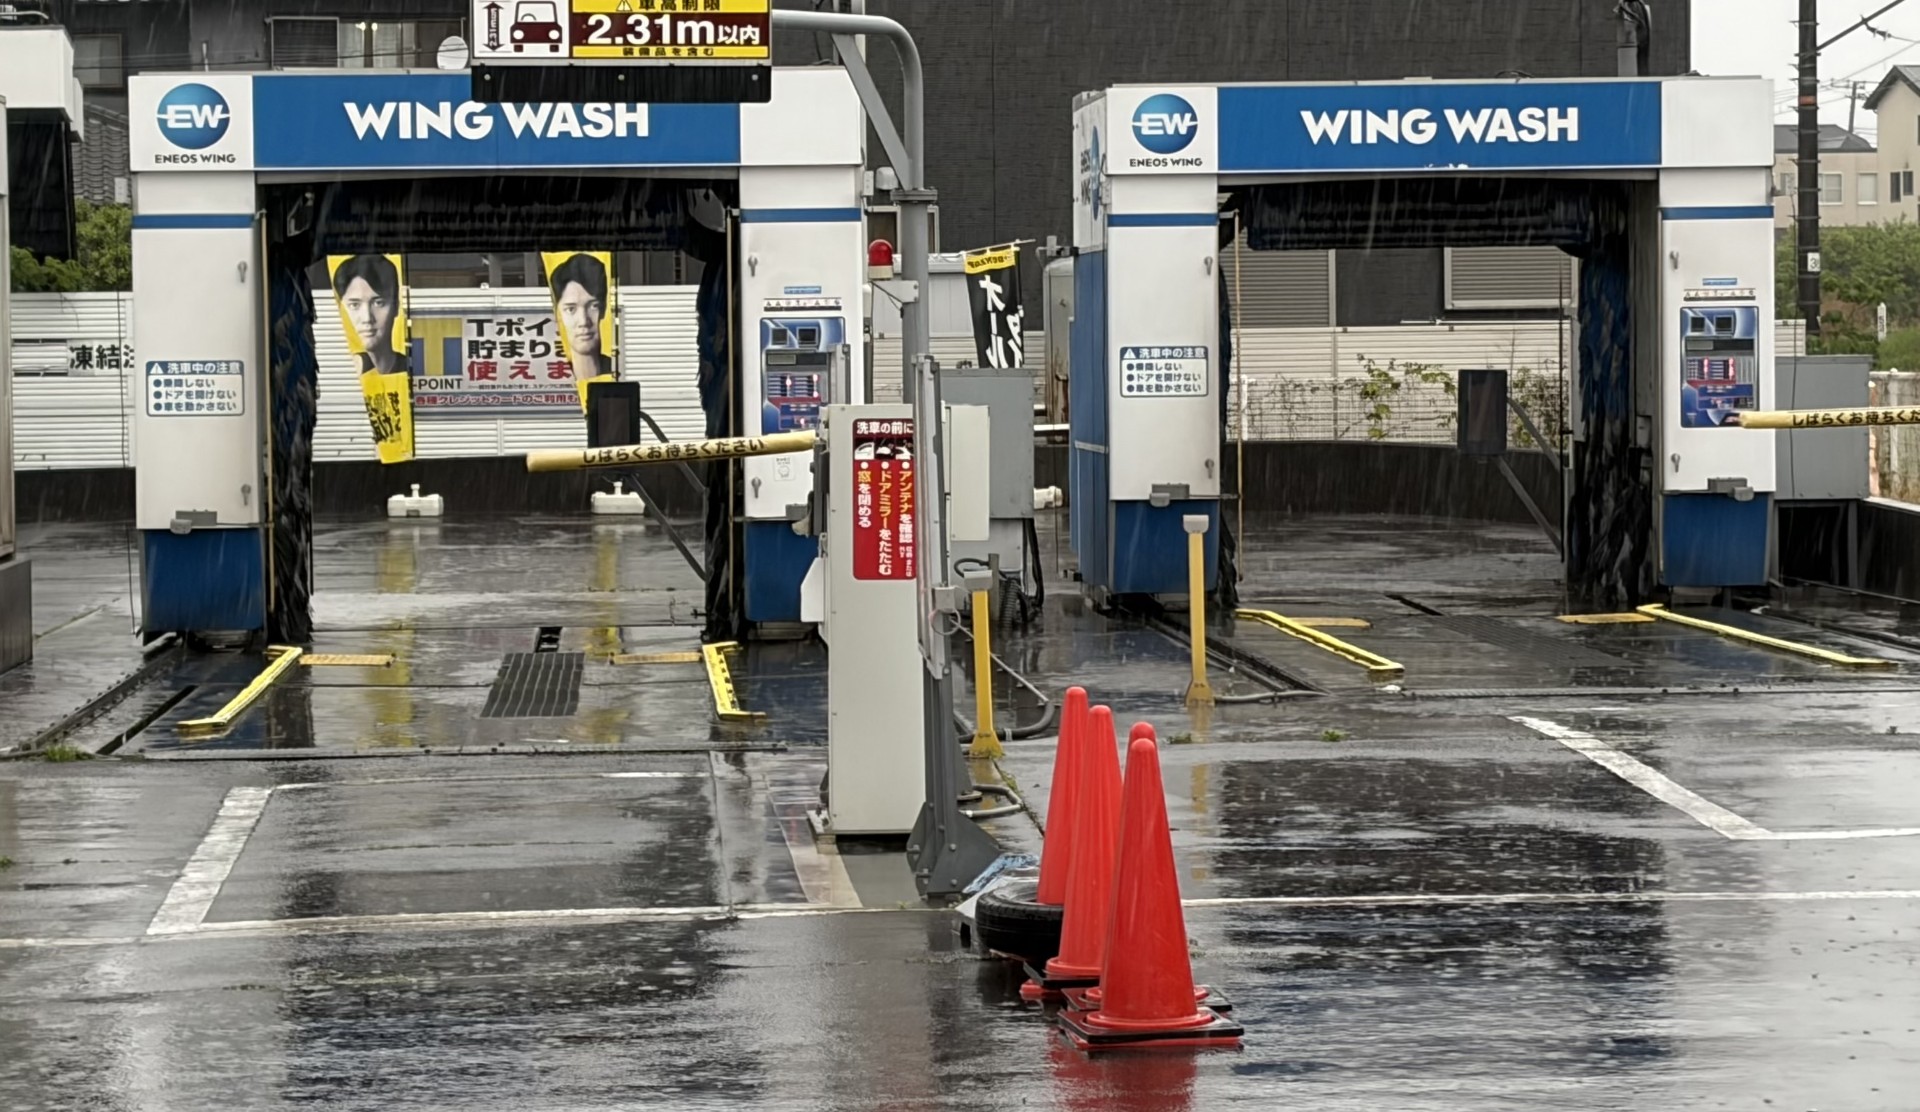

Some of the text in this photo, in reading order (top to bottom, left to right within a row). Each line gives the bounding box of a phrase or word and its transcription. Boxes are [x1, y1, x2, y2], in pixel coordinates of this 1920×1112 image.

[587, 13, 760, 45] 2.31m以内
[166, 104, 223, 128] EW
[343, 100, 649, 141] WING WASH
[1141, 113, 1192, 135] EW
[1300, 107, 1579, 145] WING WASH
[154, 153, 237, 164] ENEOS WING
[1129, 157, 1203, 168] ENEOS WING
[466, 317, 561, 337] Tポイ
[1139, 348, 1206, 359] 洗車中の注意
[167, 362, 241, 374] 洗車中の注意
[856, 421, 915, 435] 洗車の前に
[583, 439, 765, 464] しばらくお待ちください
[878, 470, 893, 575] ドアミラーをたたむ
